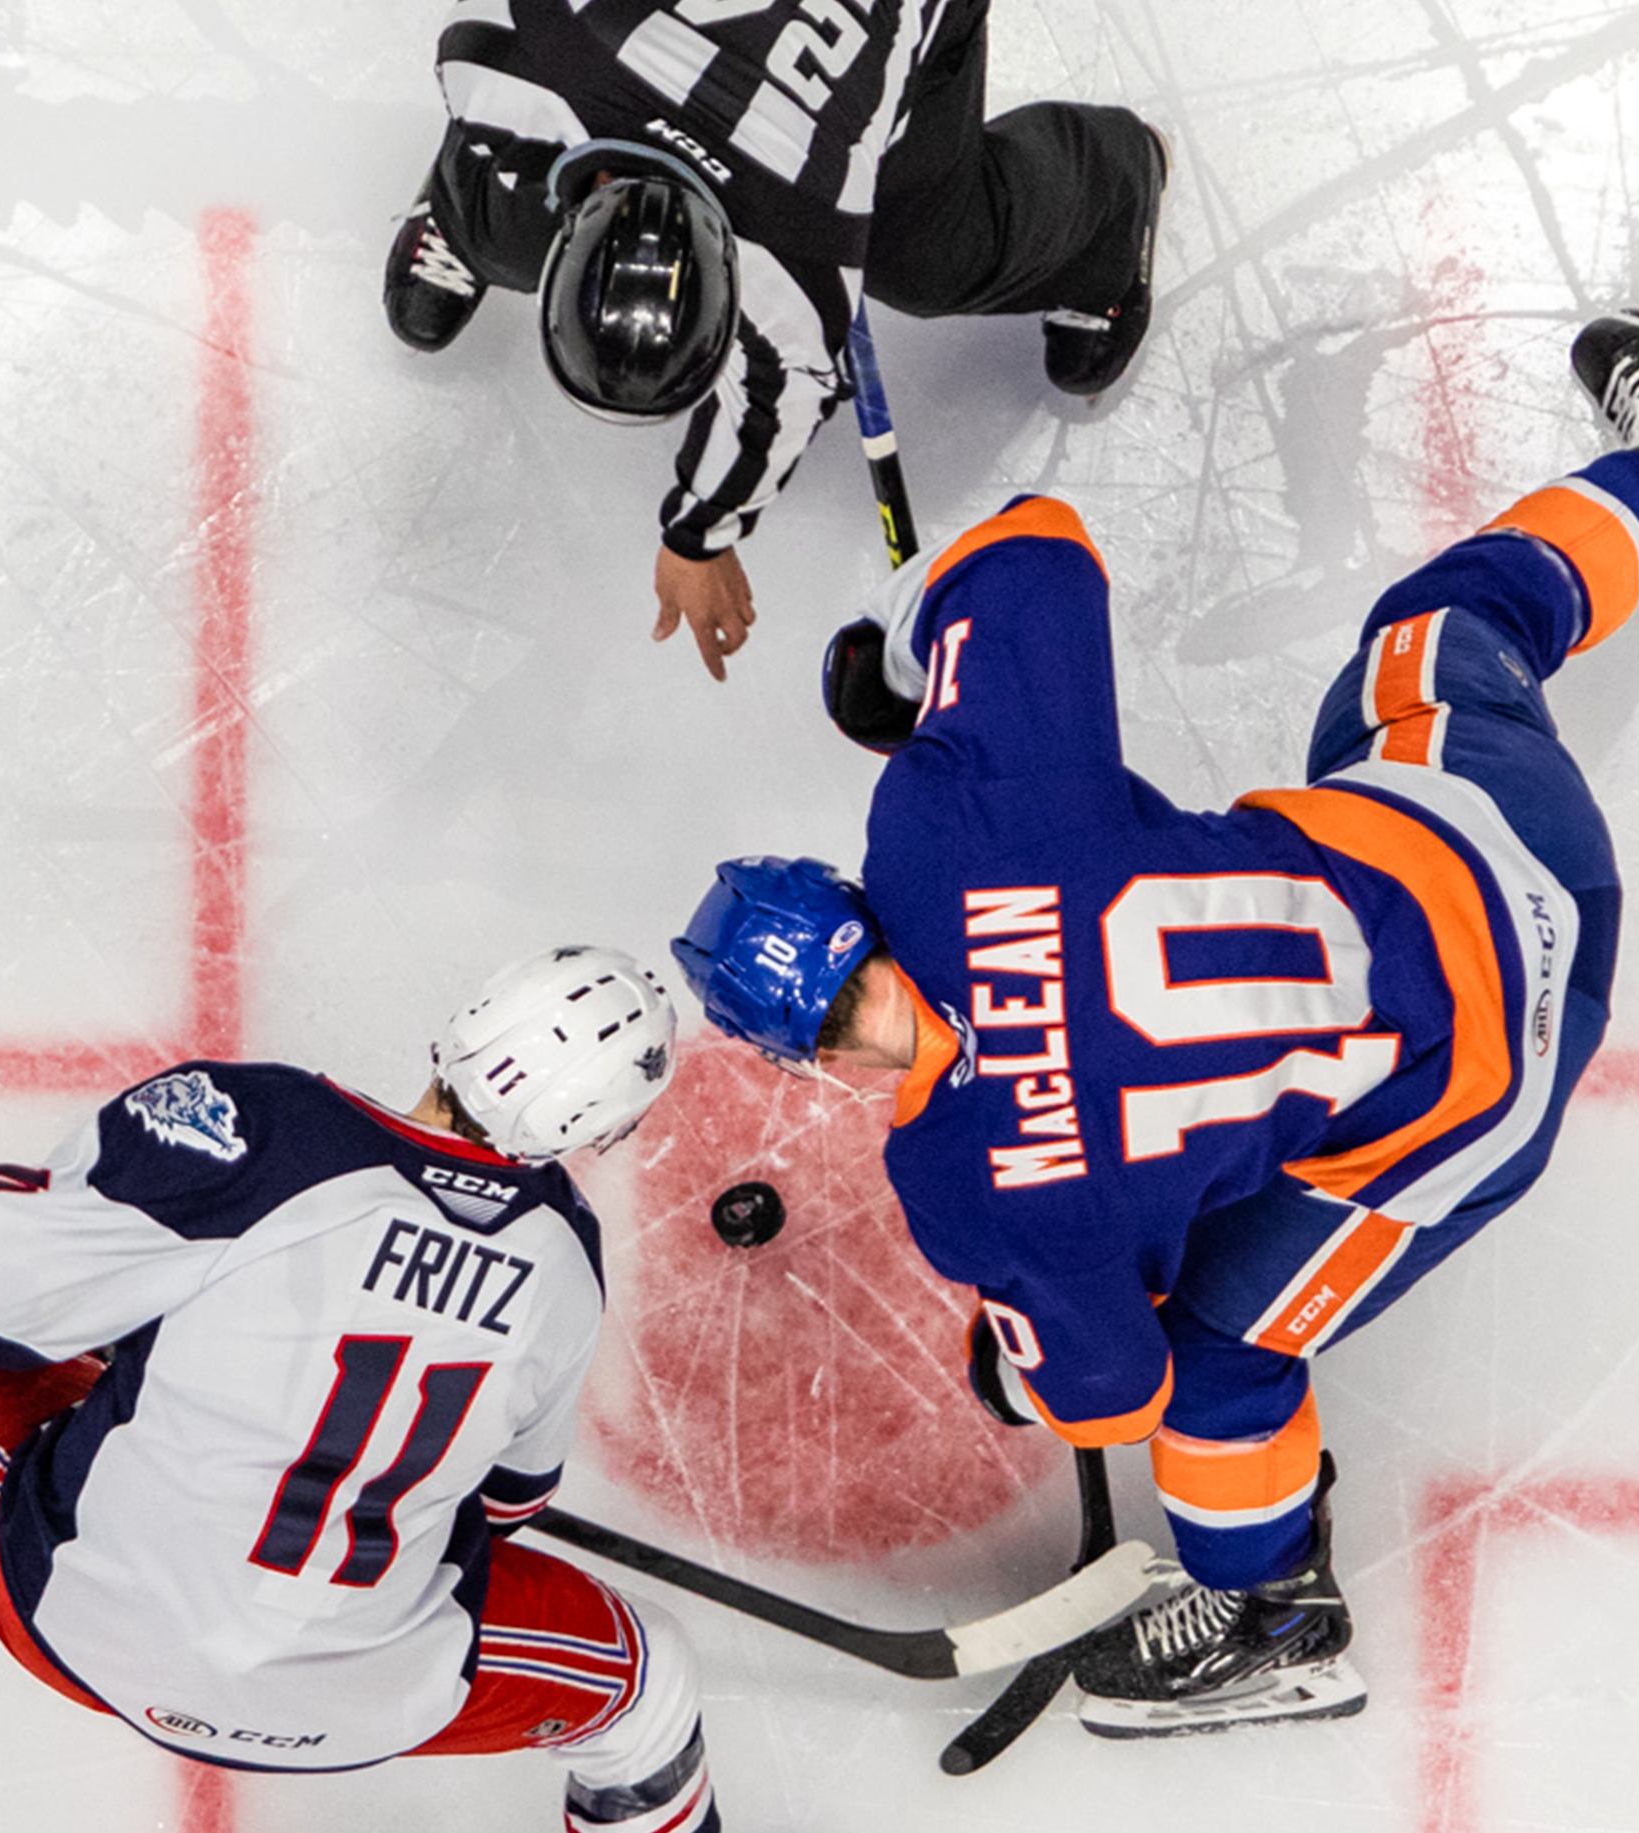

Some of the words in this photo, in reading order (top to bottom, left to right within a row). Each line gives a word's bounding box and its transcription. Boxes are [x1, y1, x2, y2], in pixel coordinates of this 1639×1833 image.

[646, 118, 733, 185] CCM
[755, 934, 798, 977] 10
[1526, 892, 1556, 980] CCM
[1100, 871, 1402, 1162] 10
[486, 1055, 528, 1097] 11
[422, 1165, 519, 1202] CCM
[362, 1218, 535, 1336] FRITZ
[1286, 1285, 1342, 1335] CCM
[248, 1334, 493, 1588] 11
[229, 1729, 328, 1749] CCM
